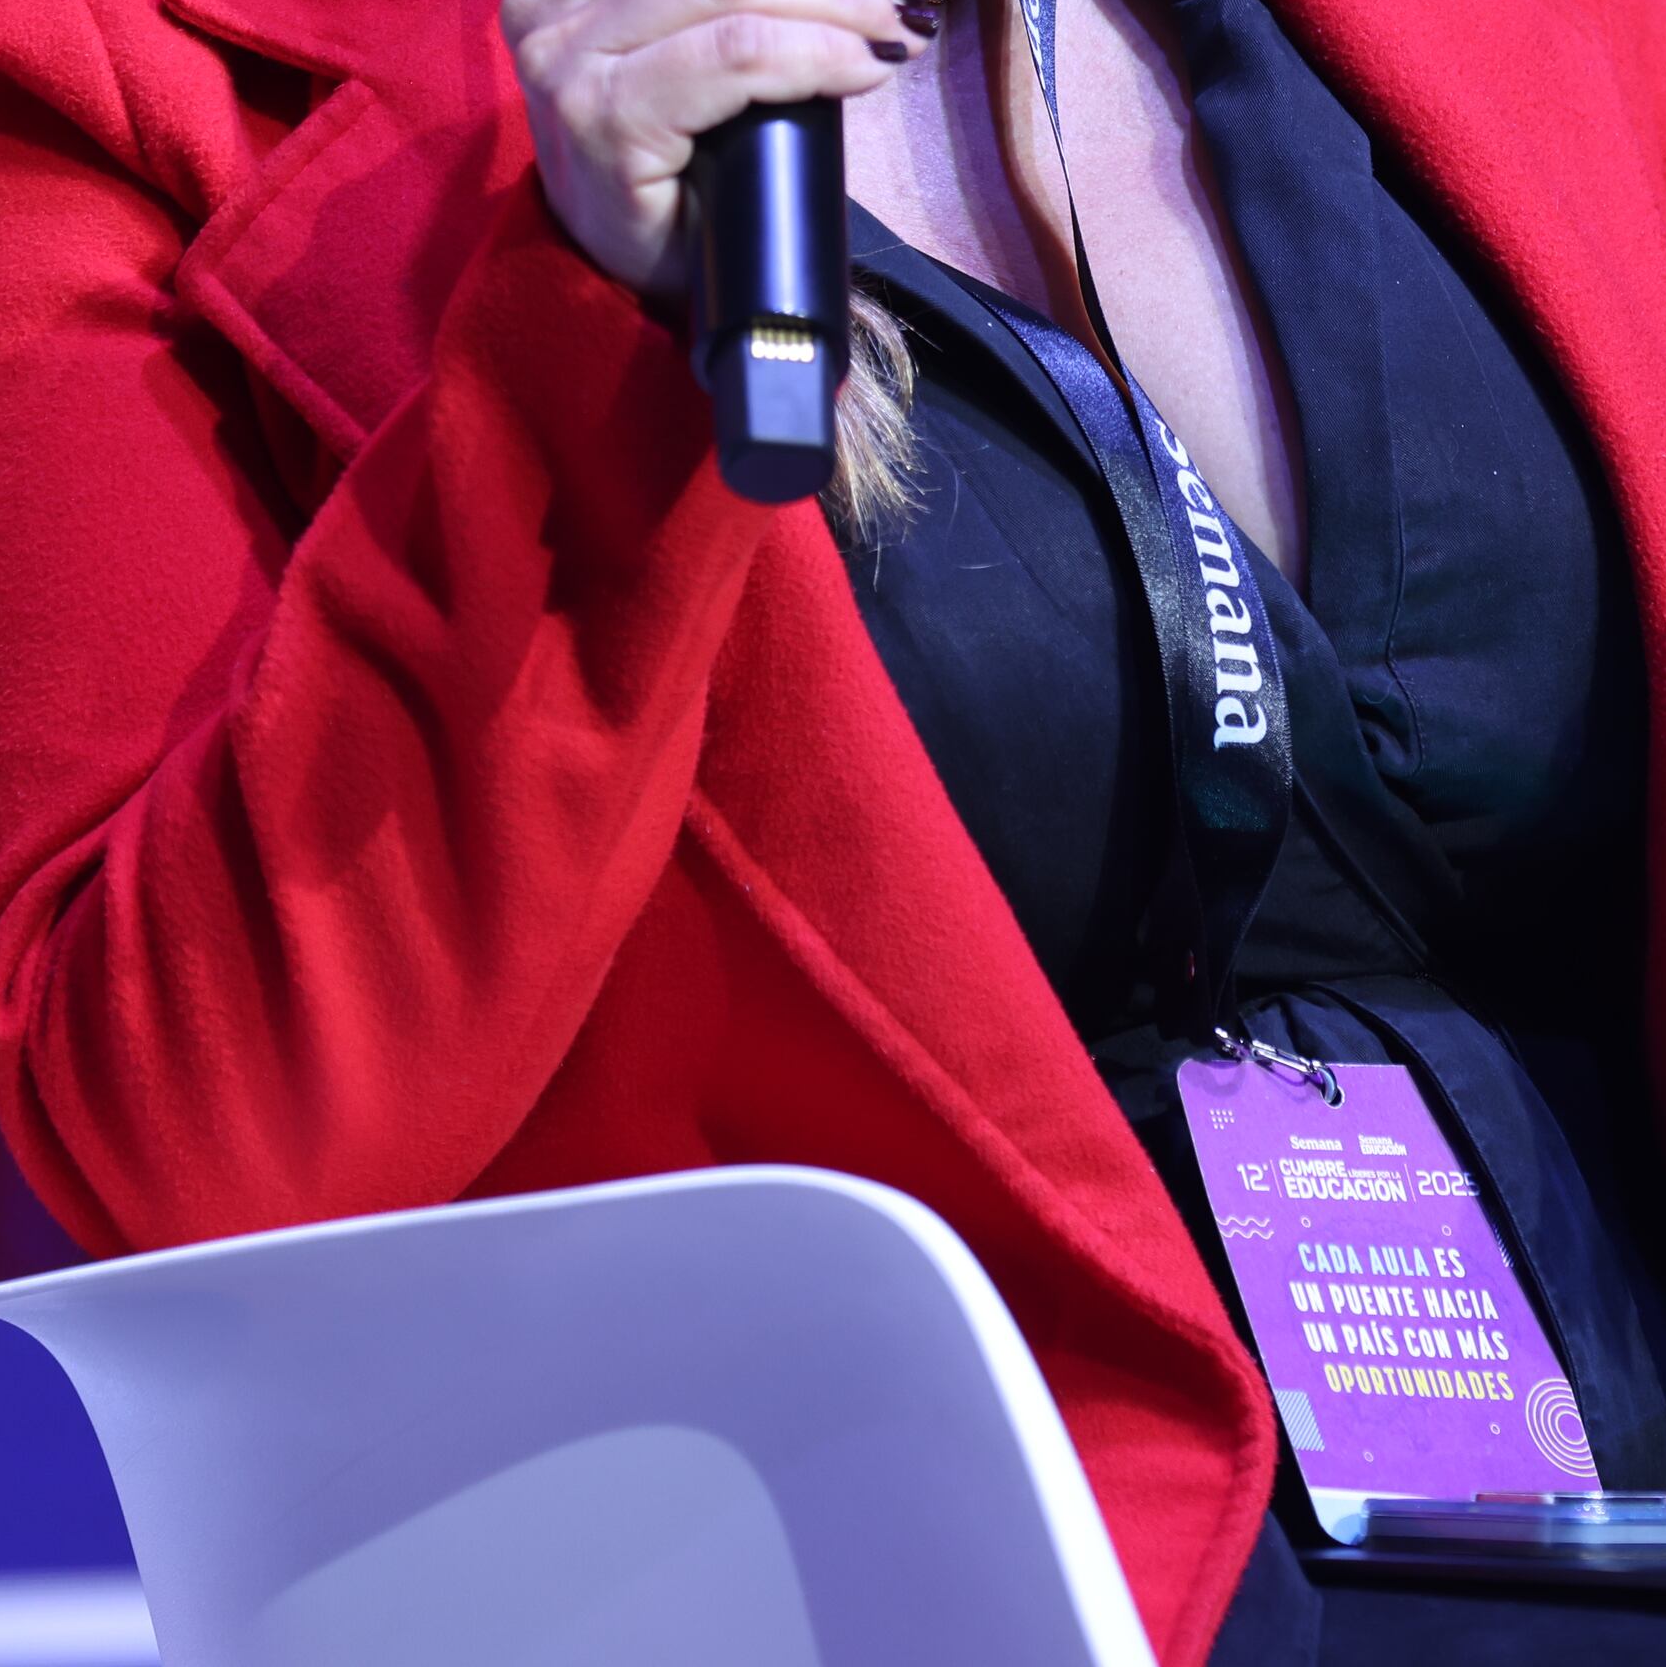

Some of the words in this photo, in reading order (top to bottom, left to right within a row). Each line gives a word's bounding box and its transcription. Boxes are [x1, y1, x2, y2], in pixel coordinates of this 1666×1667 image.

[1289, 1135, 1343, 1151] Semana
[1279, 1158, 1348, 1178] CUMBRE
[1283, 1175, 1408, 1202] EDUCACIÓN
[1298, 1243, 1363, 1275] CADA
[1368, 1245, 1431, 1277] AULA
[1433, 1247, 1466, 1278] ES
[1289, 1282, 1325, 1313] UN
[1328, 1284, 1420, 1317] PUENTE
[1422, 1288, 1500, 1320] HACIA
[1302, 1322, 1338, 1354] UN
[1340, 1320, 1400, 1357] PAÍS
[1402, 1327, 1453, 1359] CON
[1456, 1325, 1510, 1361] MÁS
[1323, 1364, 1515, 1402] OPORTUNIDADES
